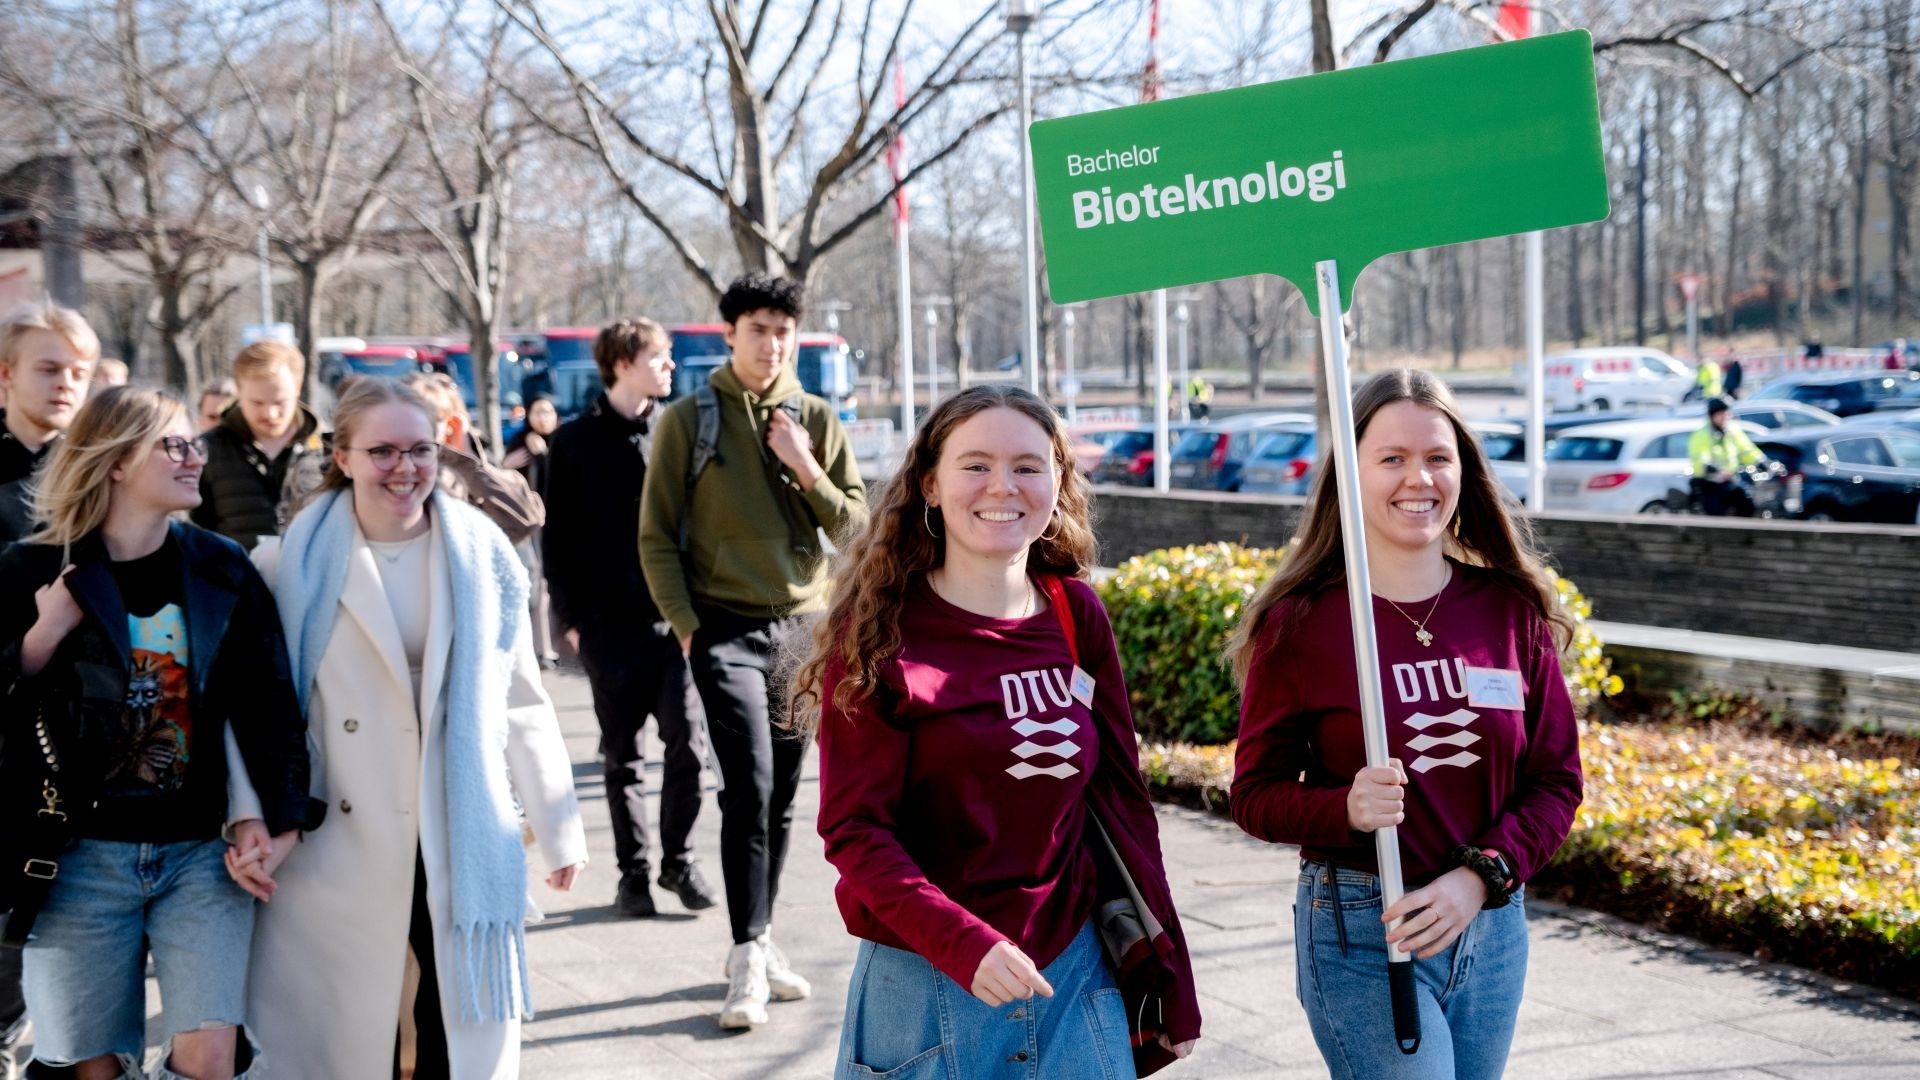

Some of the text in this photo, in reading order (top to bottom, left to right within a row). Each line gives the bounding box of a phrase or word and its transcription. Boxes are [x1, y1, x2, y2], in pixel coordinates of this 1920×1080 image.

[1067, 145, 1160, 176] Bachelor
[1073, 151, 1346, 229] Bioteknologi
[1000, 668, 1073, 719] DTU
[1392, 657, 1469, 703] DTU
